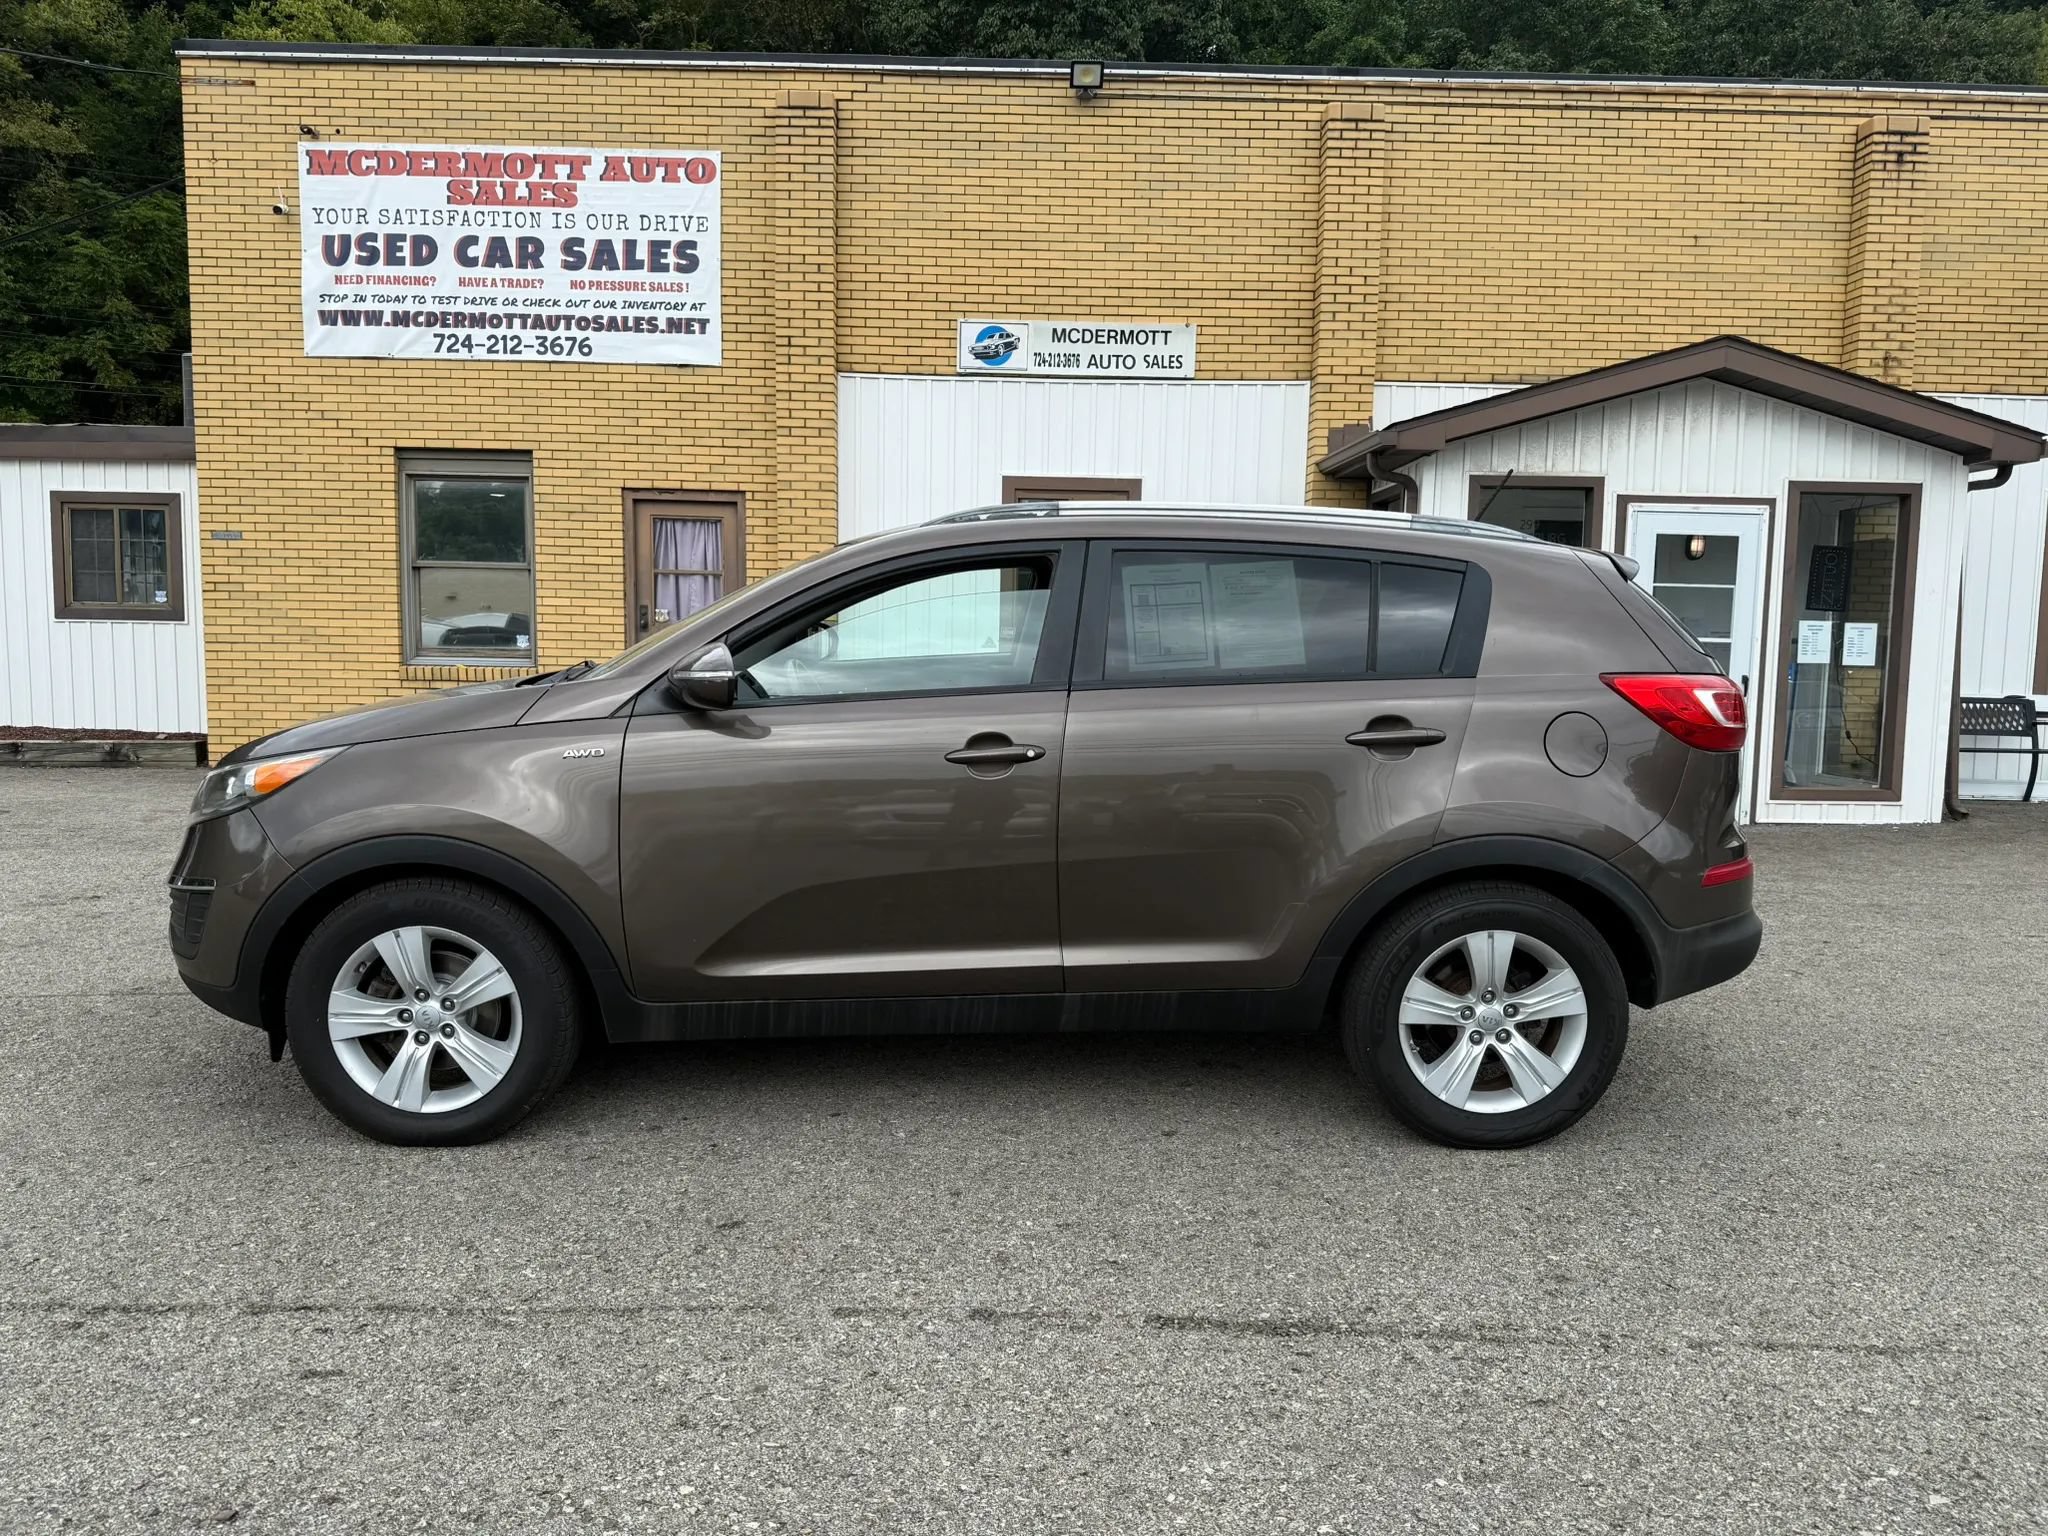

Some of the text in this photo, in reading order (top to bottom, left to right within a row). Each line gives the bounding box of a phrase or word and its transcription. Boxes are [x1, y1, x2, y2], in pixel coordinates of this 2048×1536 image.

[306, 149, 718, 185] MCDERMOTT AUTO
[447, 179, 578, 208] SALES
[312, 207, 709, 232] YOUR SATISFACTION IS OUR DRIVE
[321, 232, 700, 274] USED CAR SALES
[334, 275, 437, 287] NEED FINANCING?
[458, 277, 545, 289] HAVE A TRADE?
[570, 280, 586, 290] NO
[588, 280, 647, 292] PRESSURE
[319, 293, 706, 312] STOP IN TODAY TO TEST DRIVE OR CHECK OUT OUR INVENTORY AT
[317, 310, 710, 335] WWW.MCDERMOTTAUTOSALES.NET
[433, 333, 593, 357] 724-212-3676
[1051, 327, 1172, 346] MCDERMOTT
[1033, 352, 1080, 368] 724-212-3676
[1087, 353, 1183, 370] AUTO SALES
[1820, 553, 1838, 607] OPEN
[562, 748, 605, 759] AWD
